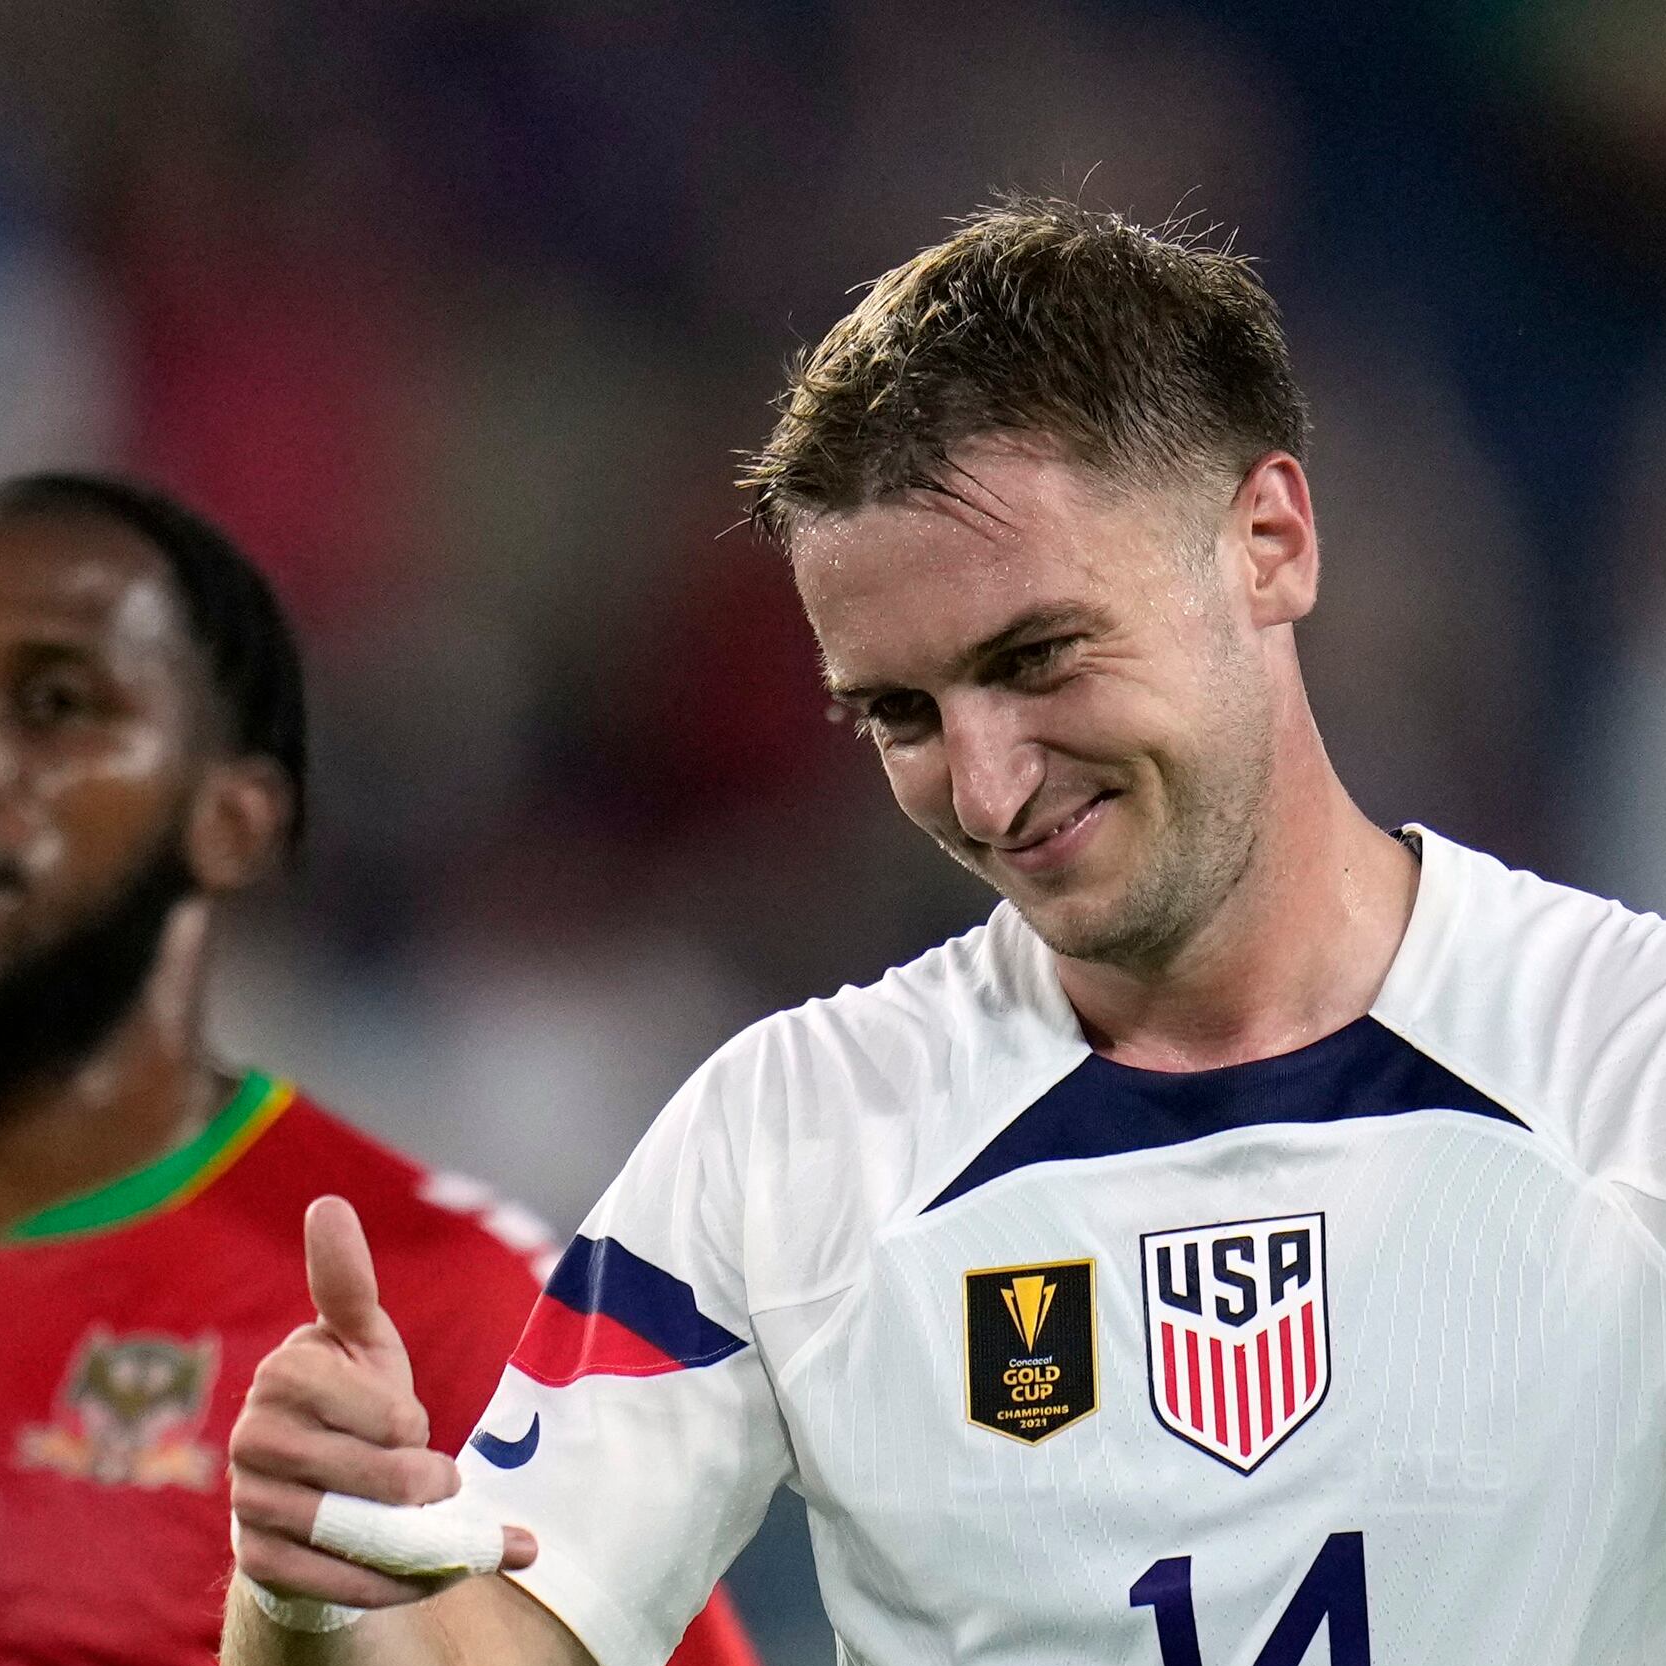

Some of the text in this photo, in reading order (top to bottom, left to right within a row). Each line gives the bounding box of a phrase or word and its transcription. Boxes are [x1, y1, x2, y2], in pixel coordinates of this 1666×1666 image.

[1156, 1228, 1311, 1327] USA
[1008, 1355, 1053, 1368] Concacaf
[1003, 1365, 1061, 1385] GOLD
[1011, 1383, 1053, 1402] CUP
[996, 1405, 1070, 1420] CHAMPIONS
[1020, 1418, 1048, 1429] 2021
